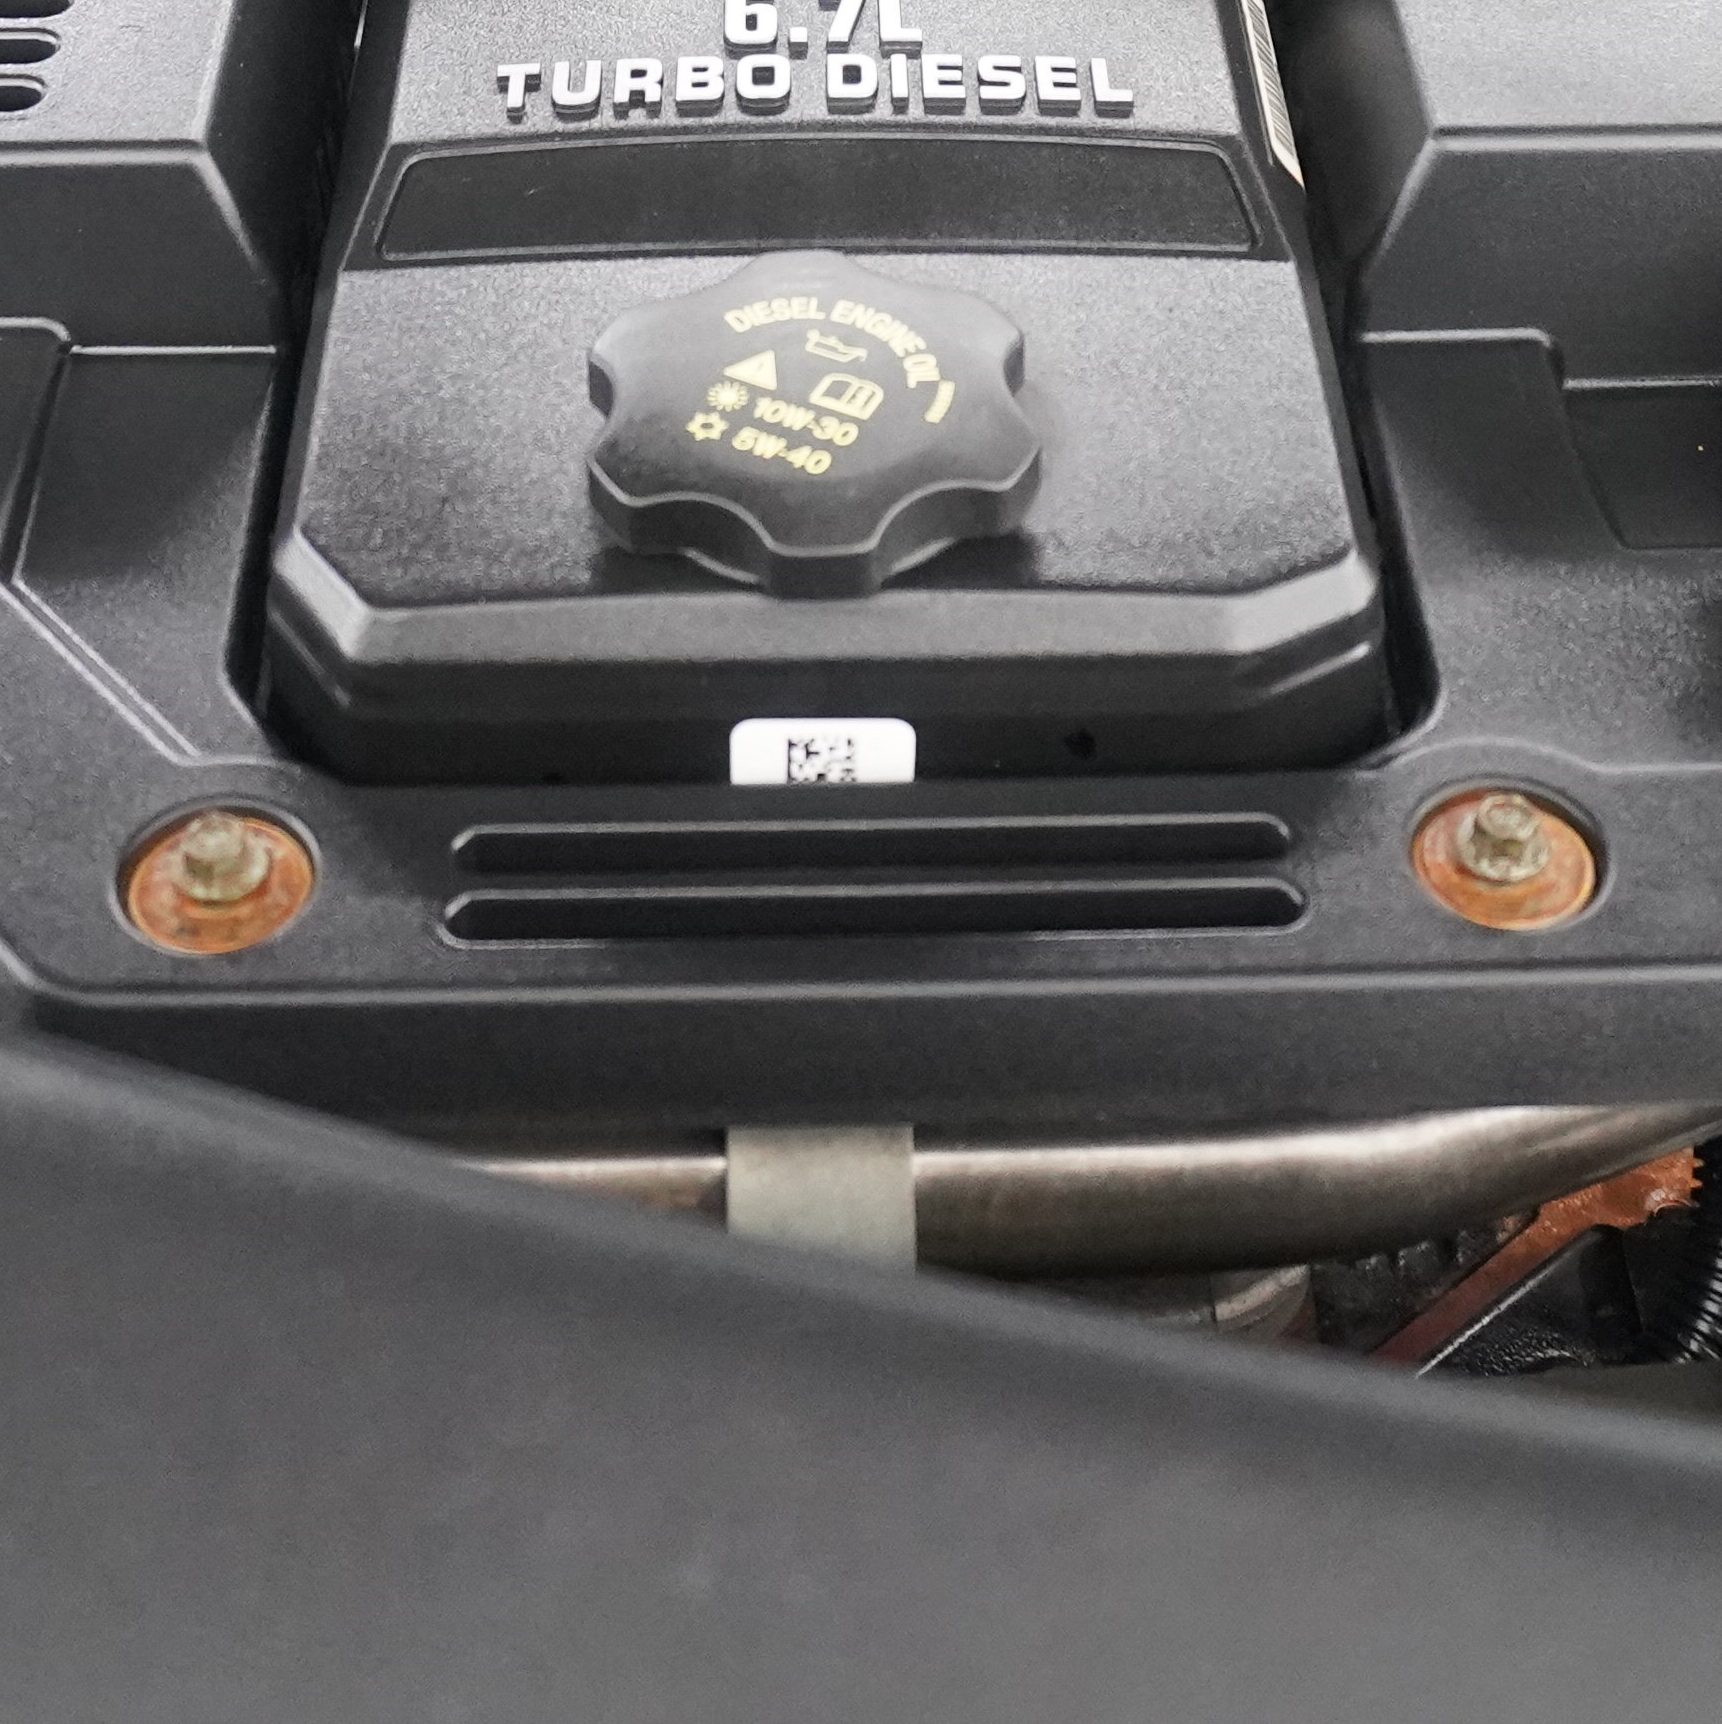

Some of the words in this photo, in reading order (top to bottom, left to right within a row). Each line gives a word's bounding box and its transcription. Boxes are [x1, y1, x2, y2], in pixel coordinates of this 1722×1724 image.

[497, 53, 792, 114] TURBO
[826, 52, 1135, 107] DIESEL
[724, 296, 826, 333] DIESEL
[829, 298, 927, 358] ENGINE
[902, 353, 941, 389] OIL
[753, 396, 859, 447] 10W-30
[731, 426, 833, 475] 5W-40
